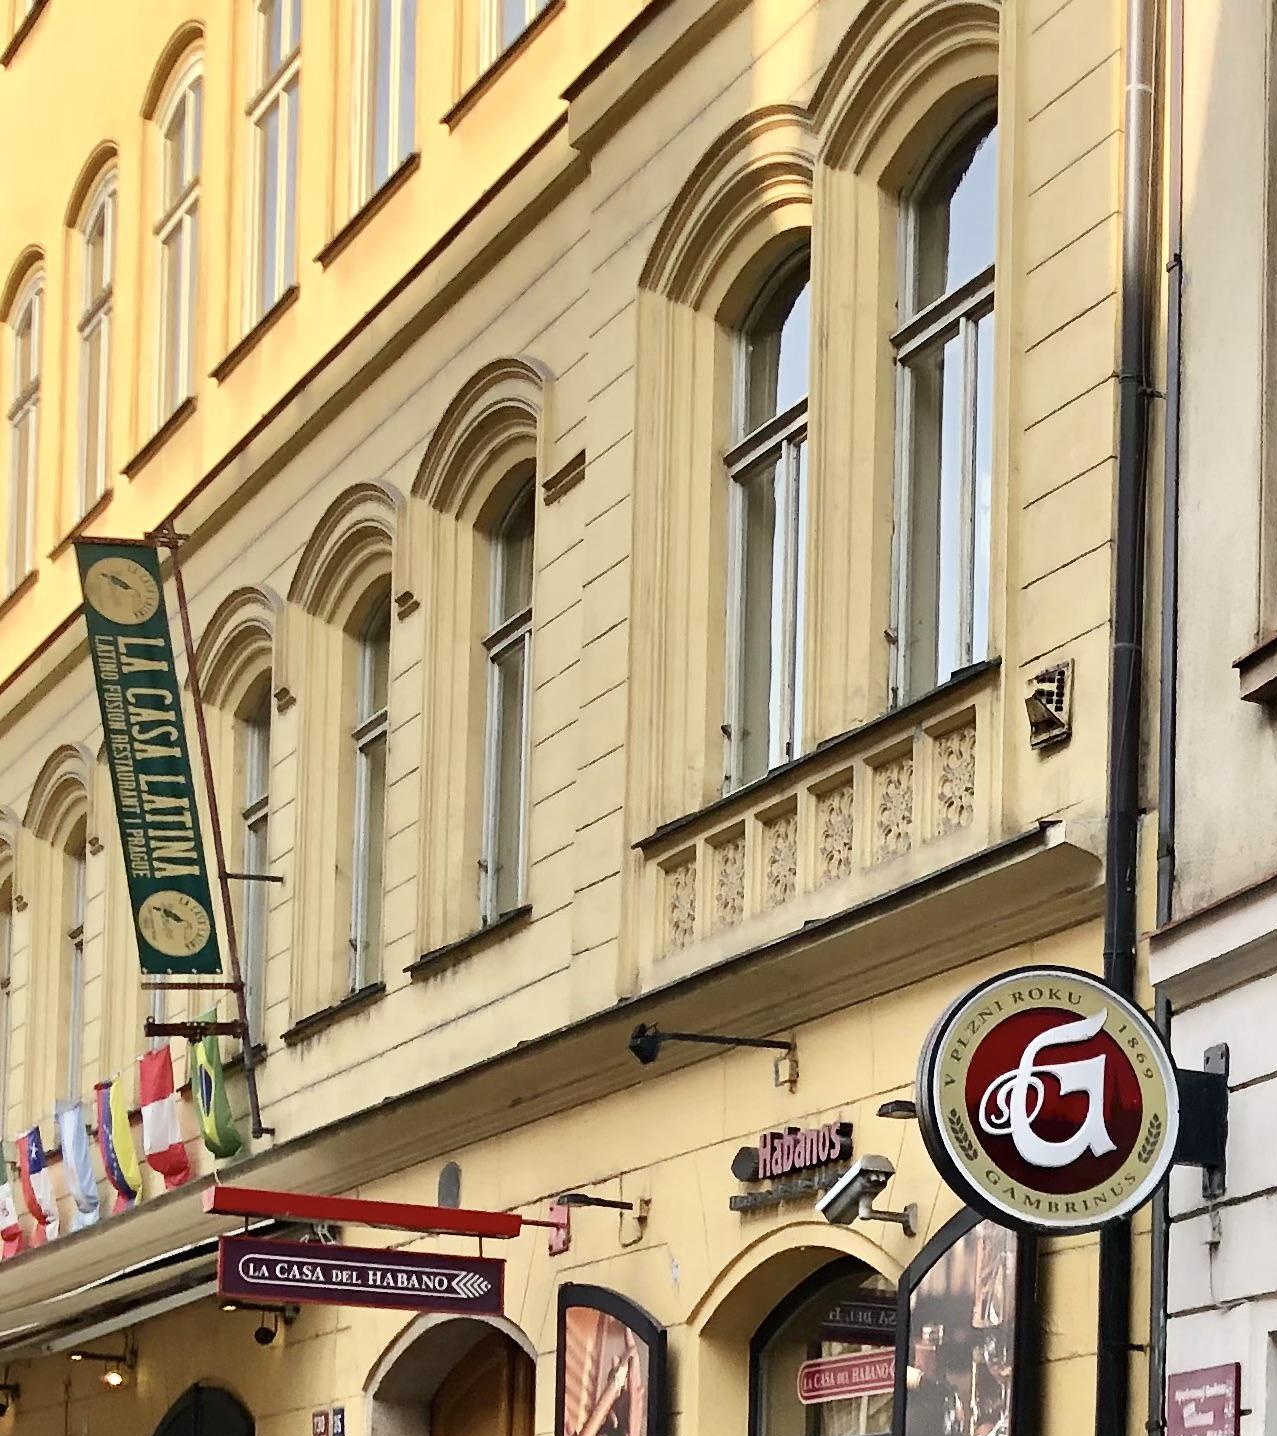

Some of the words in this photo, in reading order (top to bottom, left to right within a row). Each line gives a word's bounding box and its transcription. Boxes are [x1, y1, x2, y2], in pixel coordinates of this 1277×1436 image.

[95, 635, 119, 680] LATINO
[117, 636, 169, 674] LA
[103, 684, 128, 730] FUSION
[126, 687, 182, 760] CASA
[110, 734, 140, 814] RESTAURANT
[139, 773, 200, 879] LATINA
[125, 829, 151, 878] PRAGUE
[944, 1073, 956, 1088] V
[951, 1001, 1004, 1063] PLZNI
[1010, 987, 1083, 1006] ROKU
[1117, 1024, 1155, 1080] 1869
[758, 1122, 841, 1180] Habanos
[985, 1168, 1137, 1214] GAMBRINUS
[248, 1262, 269, 1278] LA
[275, 1263, 325, 1282] CASA
[332, 1269, 362, 1285] DEL
[368, 1270, 449, 1291] HABANO
[814, 1373, 836, 1389] CASA
[851, 1363, 889, 1383] HABANO
